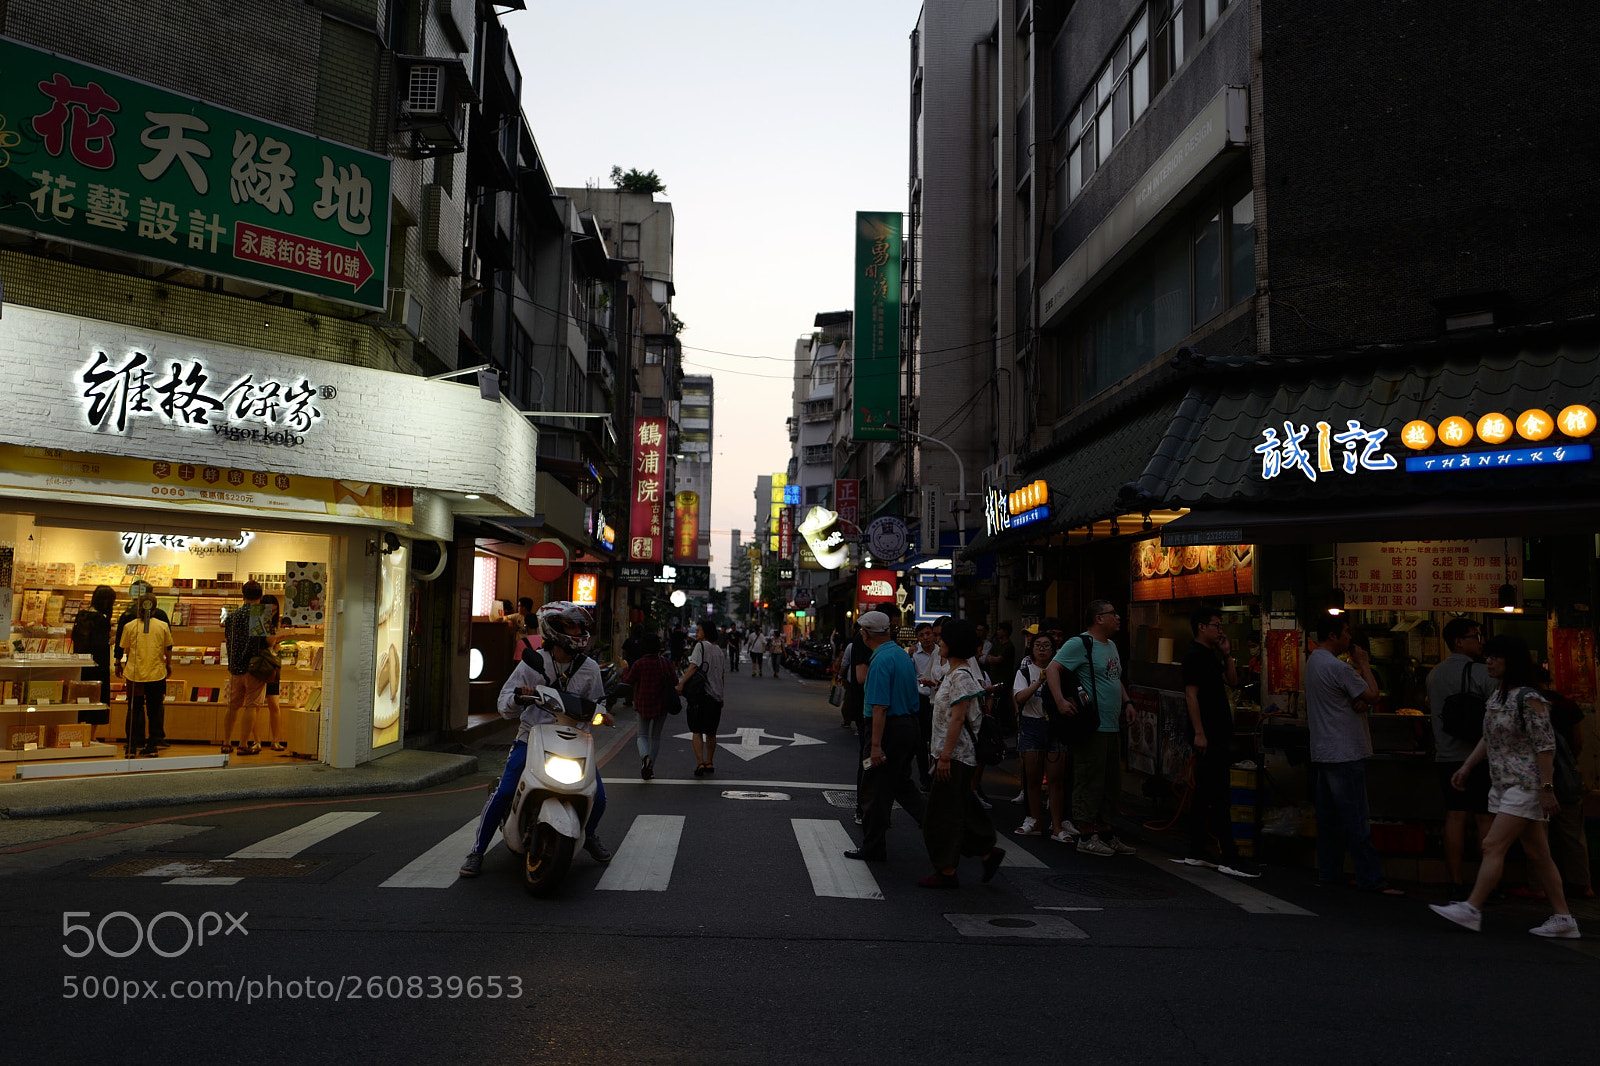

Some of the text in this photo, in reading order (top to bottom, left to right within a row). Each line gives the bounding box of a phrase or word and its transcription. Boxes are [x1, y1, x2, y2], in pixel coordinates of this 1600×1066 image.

[32, 72, 374, 237] 花天綠地
[1152, 149, 1184, 191] INTERIOR
[1184, 117, 1213, 159] DESIGN
[29, 169, 228, 254] 花藝設計
[240, 231, 361, 280] 永康街6巷10號
[82, 351, 321, 432] 維格餅家
[212, 422, 306, 447] vigor kobo
[1254, 420, 1398, 482] 誠記
[636, 421, 662, 503] 鶴浦院
[651, 503, 660, 537] 古美術
[1405, 557, 1417, 567] 25
[1405, 570, 1417, 580] 30
[1344, 595, 1417, 606] .火腿加蛋 40
[1405, 583, 1417, 593] 35
